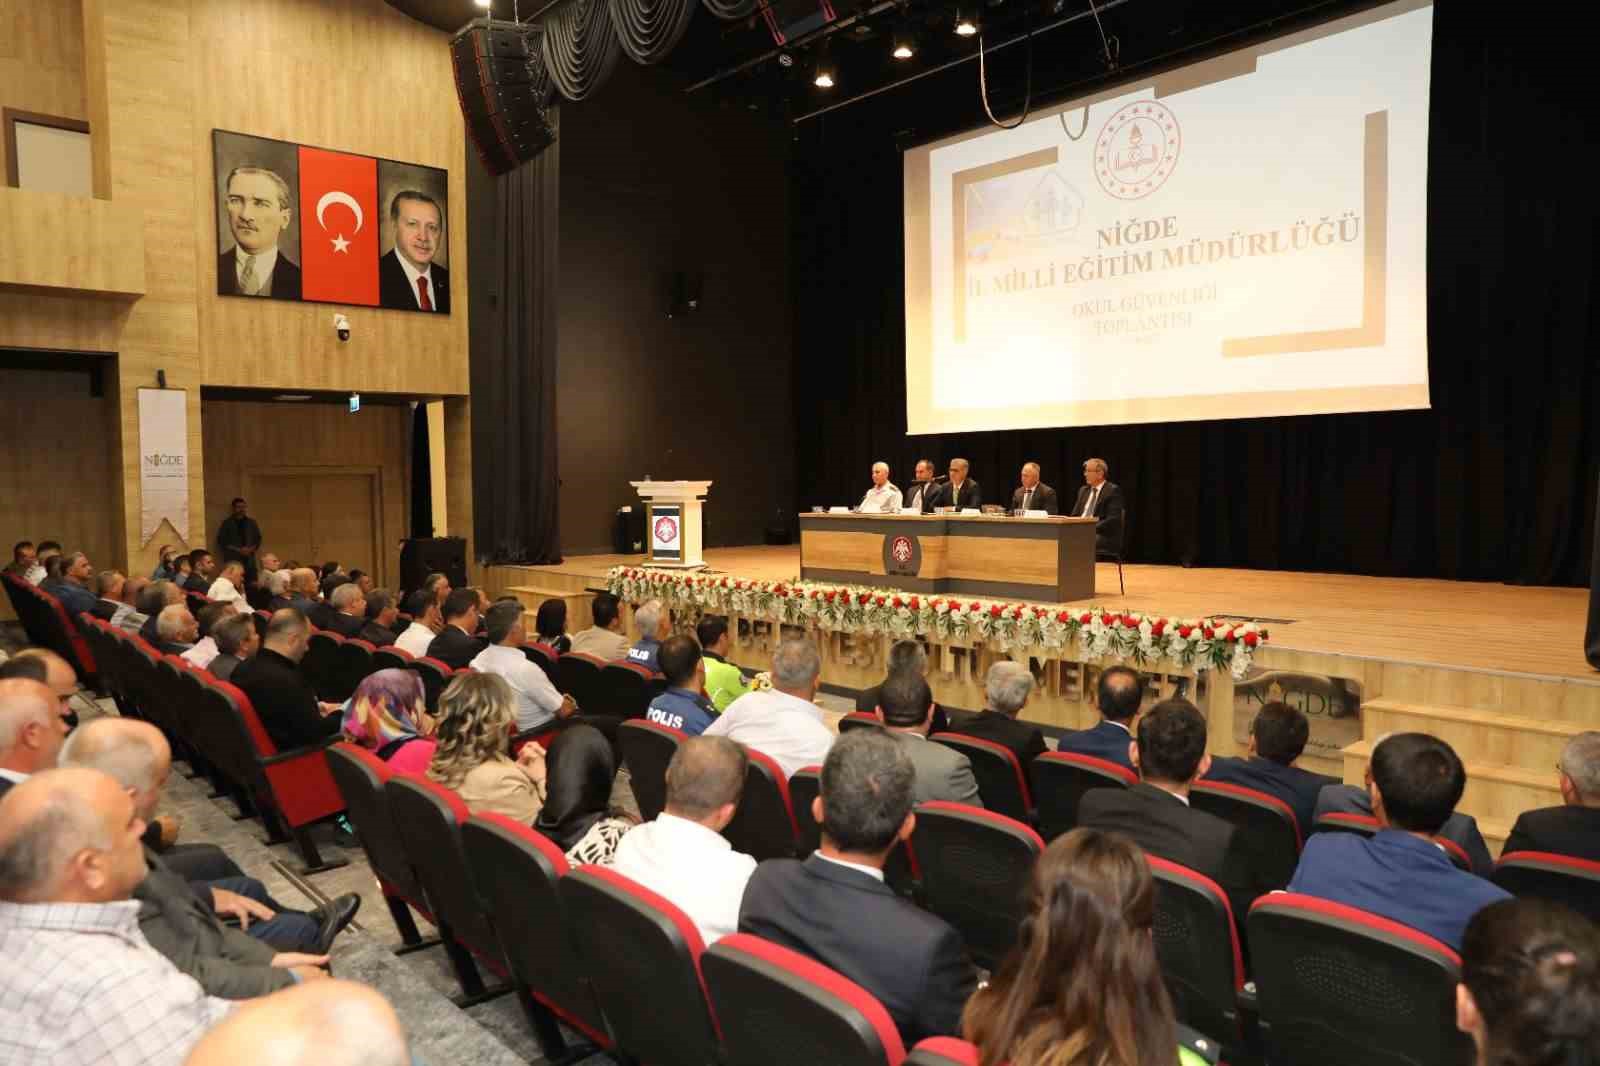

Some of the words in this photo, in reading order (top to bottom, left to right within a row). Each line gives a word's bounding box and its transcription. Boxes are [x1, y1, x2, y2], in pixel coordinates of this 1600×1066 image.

[1096, 215, 1179, 249] NİĞDE
[992, 259, 1057, 294] MİLLİ
[1063, 249, 1154, 285] EĞİTİM
[1161, 212, 1361, 269] MÜDÜRLÜĞÜ
[1072, 297, 1116, 317] OKUL
